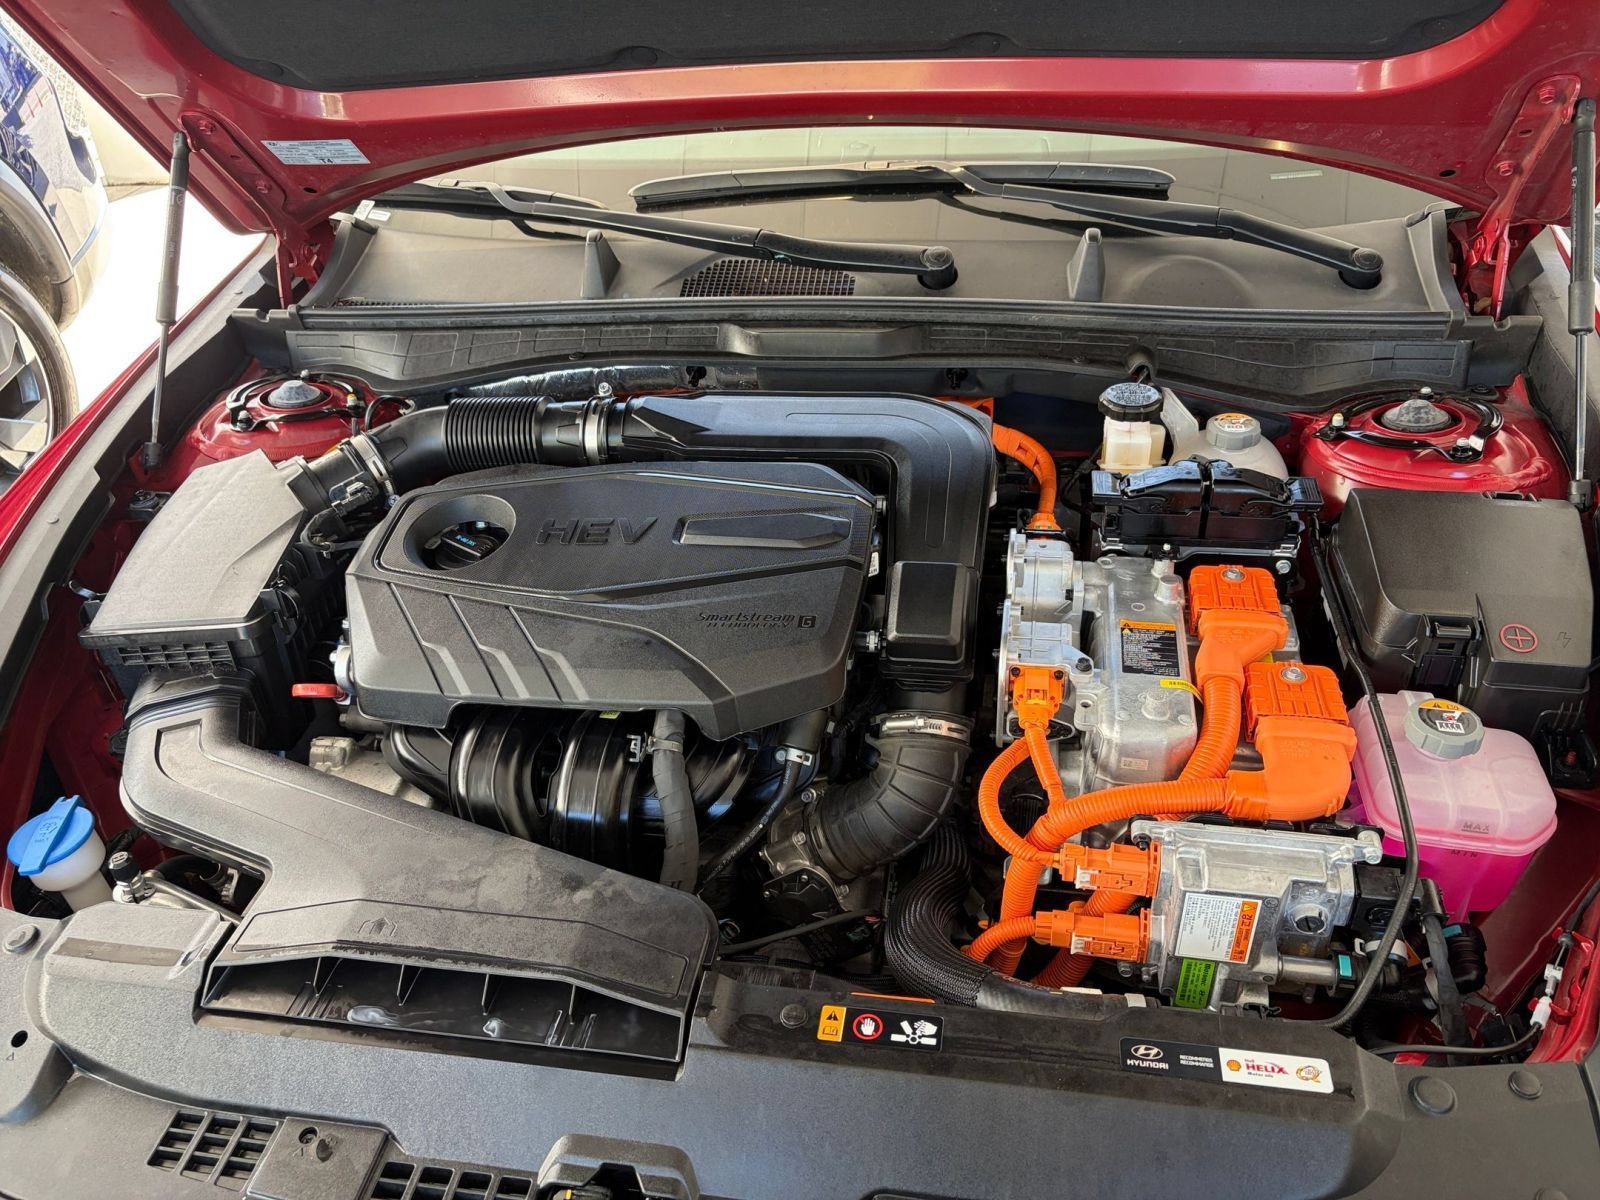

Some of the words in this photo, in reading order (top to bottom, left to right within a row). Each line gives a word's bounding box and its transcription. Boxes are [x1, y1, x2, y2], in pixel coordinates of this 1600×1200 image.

[535, 517, 658, 545] HEV
[699, 612, 795, 621] Smartstream
[800, 616, 815, 628] G
[1463, 821, 1489, 832] MAX
[1126, 1059, 1169, 1070] HYUNDAI
[1245, 1063, 1288, 1075] HELIX
